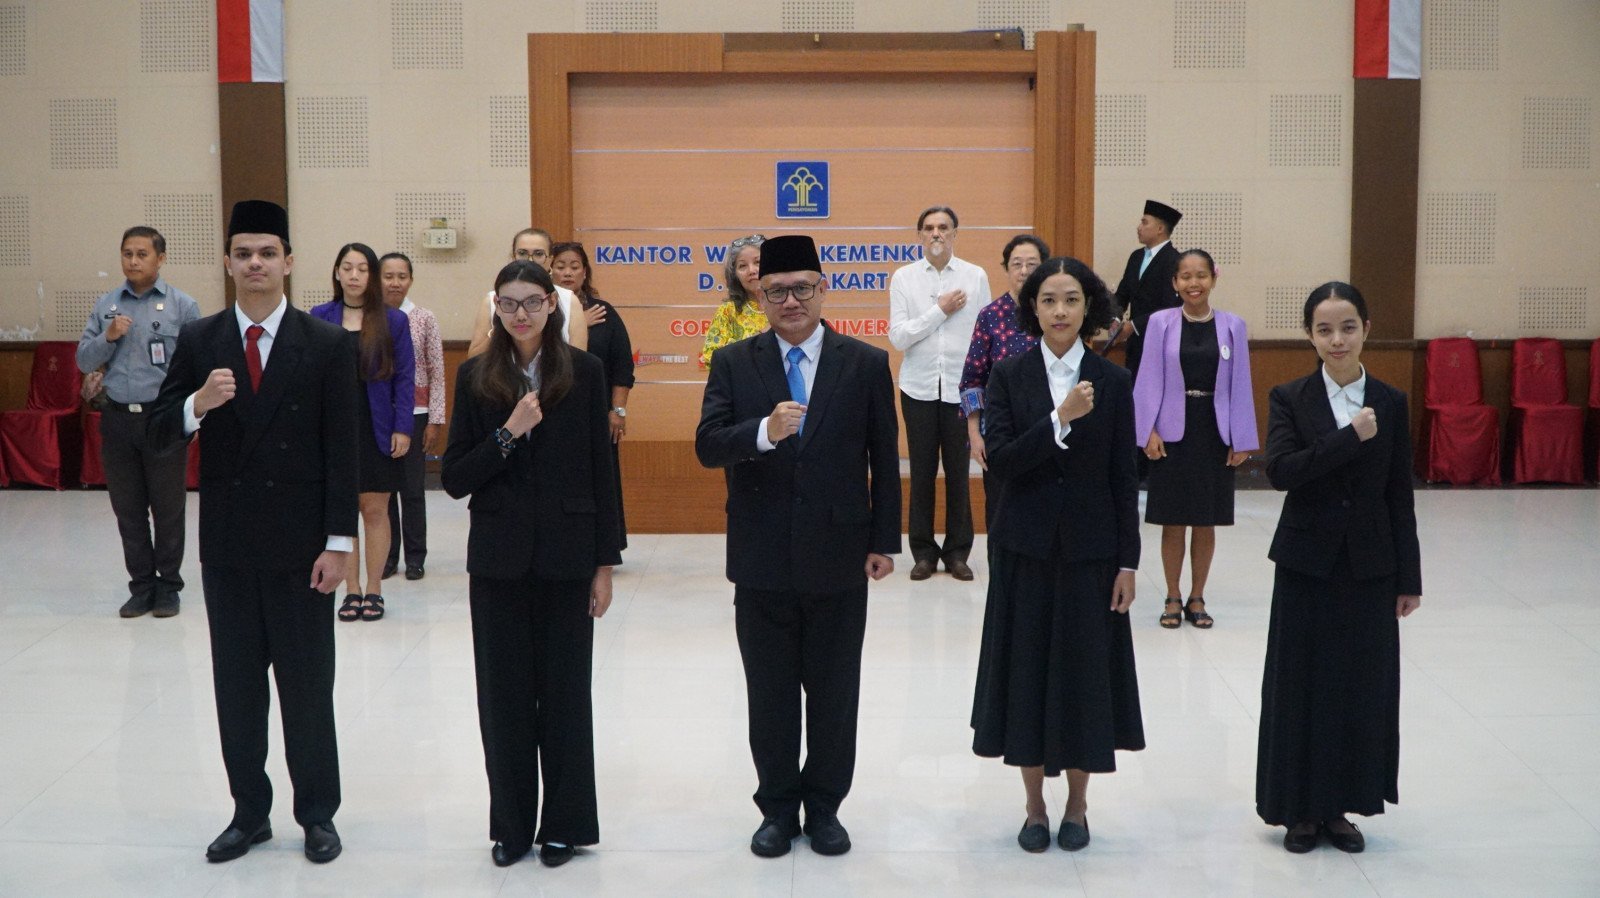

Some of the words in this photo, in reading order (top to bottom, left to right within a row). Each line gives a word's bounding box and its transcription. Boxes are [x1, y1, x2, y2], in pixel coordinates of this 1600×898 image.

[596, 246, 692, 263] KANTOR
[820, 246, 924, 263] KEMENK
[698, 273, 723, 291] D.
[825, 319, 888, 336] NIVER
